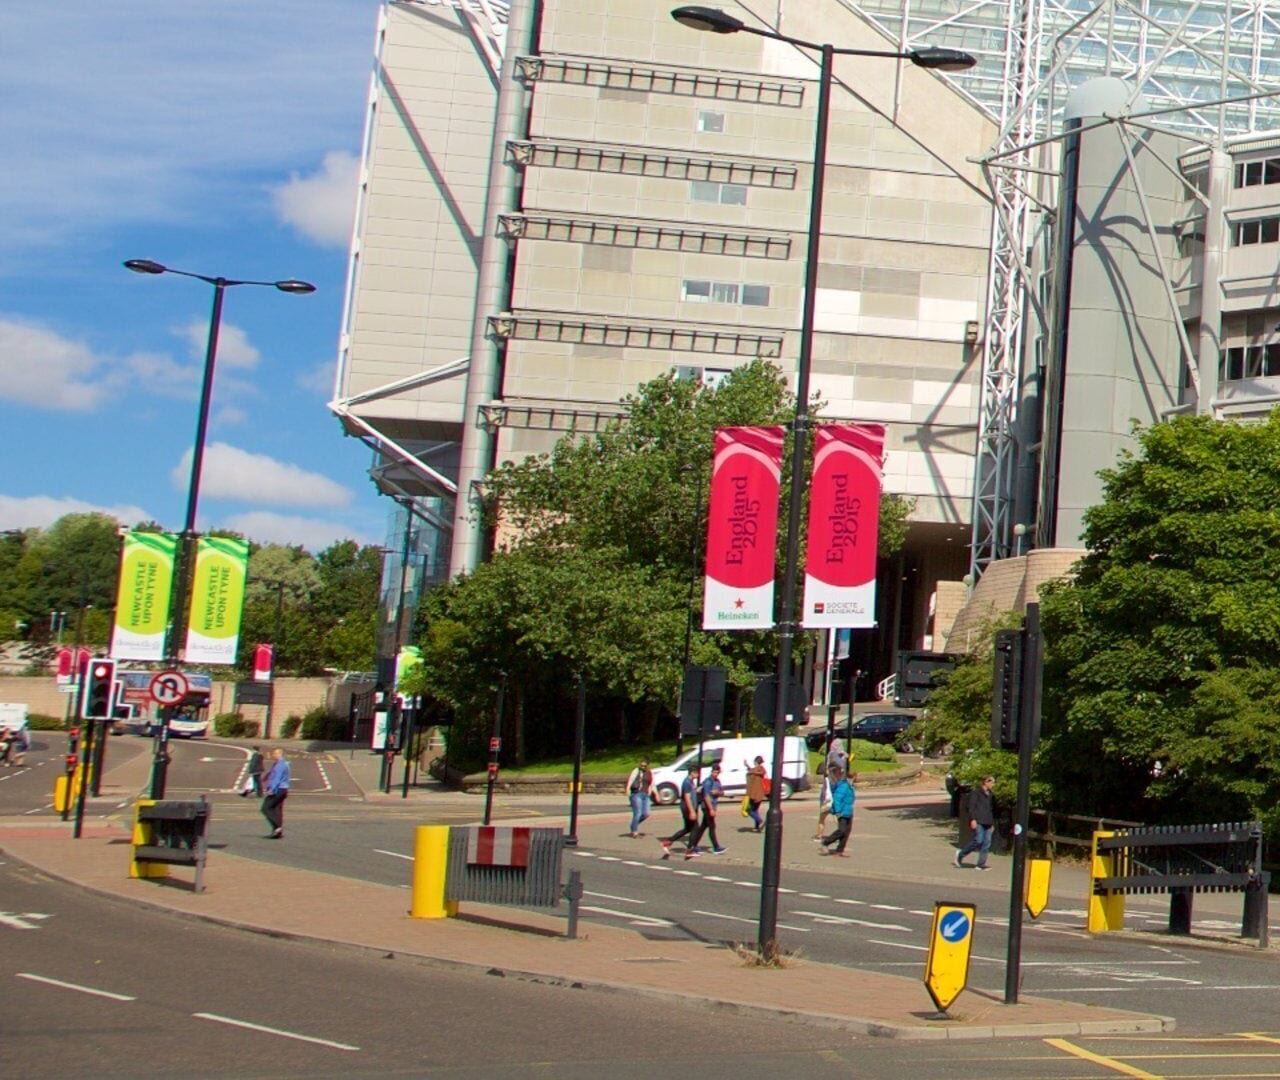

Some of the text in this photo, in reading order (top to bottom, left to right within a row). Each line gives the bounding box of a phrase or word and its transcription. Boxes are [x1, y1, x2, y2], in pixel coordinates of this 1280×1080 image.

[725, 476, 748, 566] England
[743, 499, 761, 549] 2015
[826, 474, 848, 564] England
[843, 497, 861, 547] 2015
[130, 561, 146, 626] NEWCASTLE
[142, 561, 158, 624] UPON TYNE
[204, 566, 219, 630] NEWCASTLE
[215, 566, 231, 628] UPON TYNE
[717, 611, 760, 620] Heineken
